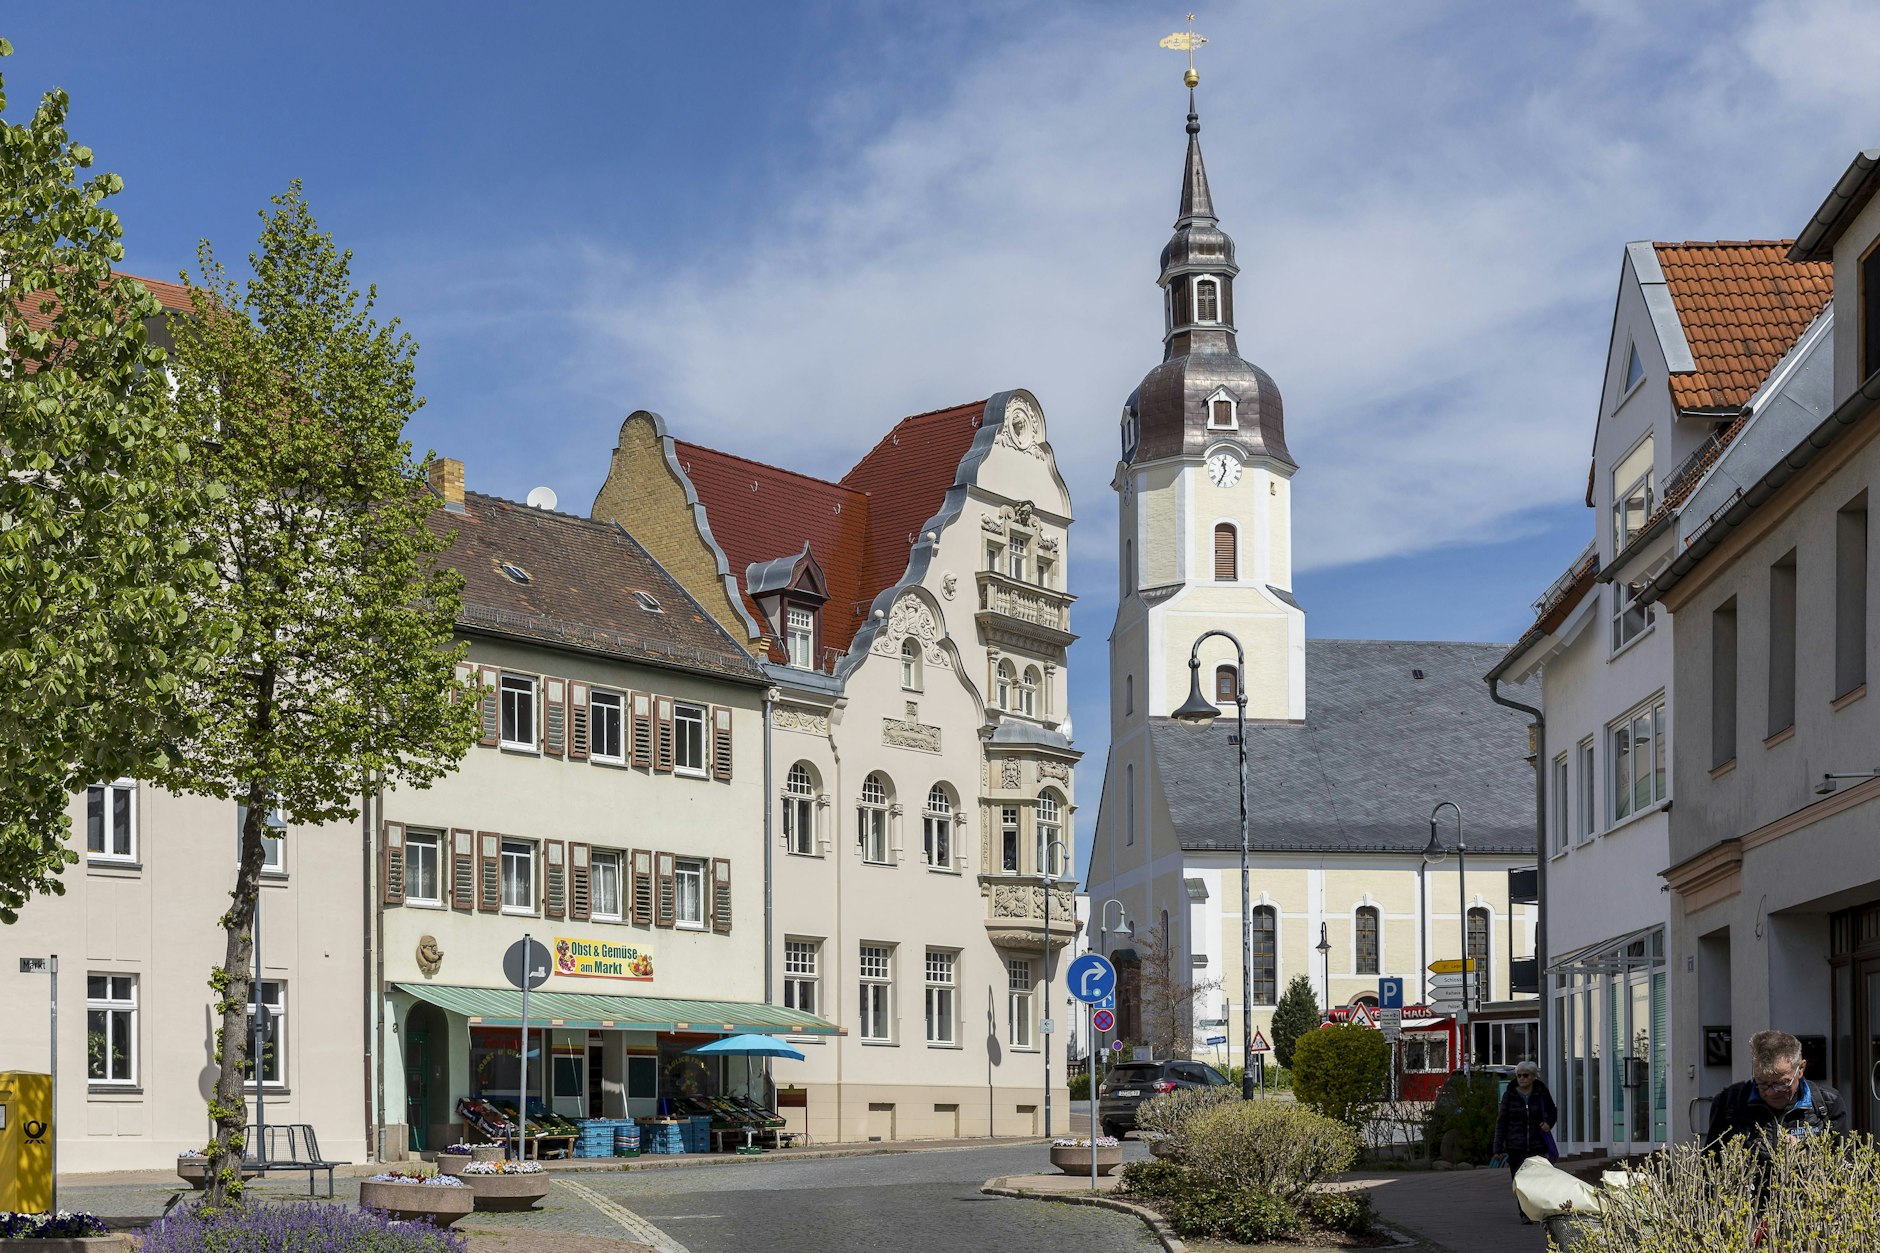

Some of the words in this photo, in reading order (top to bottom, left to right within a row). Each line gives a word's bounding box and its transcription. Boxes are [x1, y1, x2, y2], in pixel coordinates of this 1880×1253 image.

[571, 941, 591, 956] Obst
[593, 945, 600, 957] &
[601, 944, 638, 960] Gemüse
[23, 960, 46, 969] Markt
[580, 964, 592, 973] am
[594, 960, 622, 975] Markt
[1383, 981, 1397, 1006] P
[1403, 1008, 1432, 1019] HAUS
